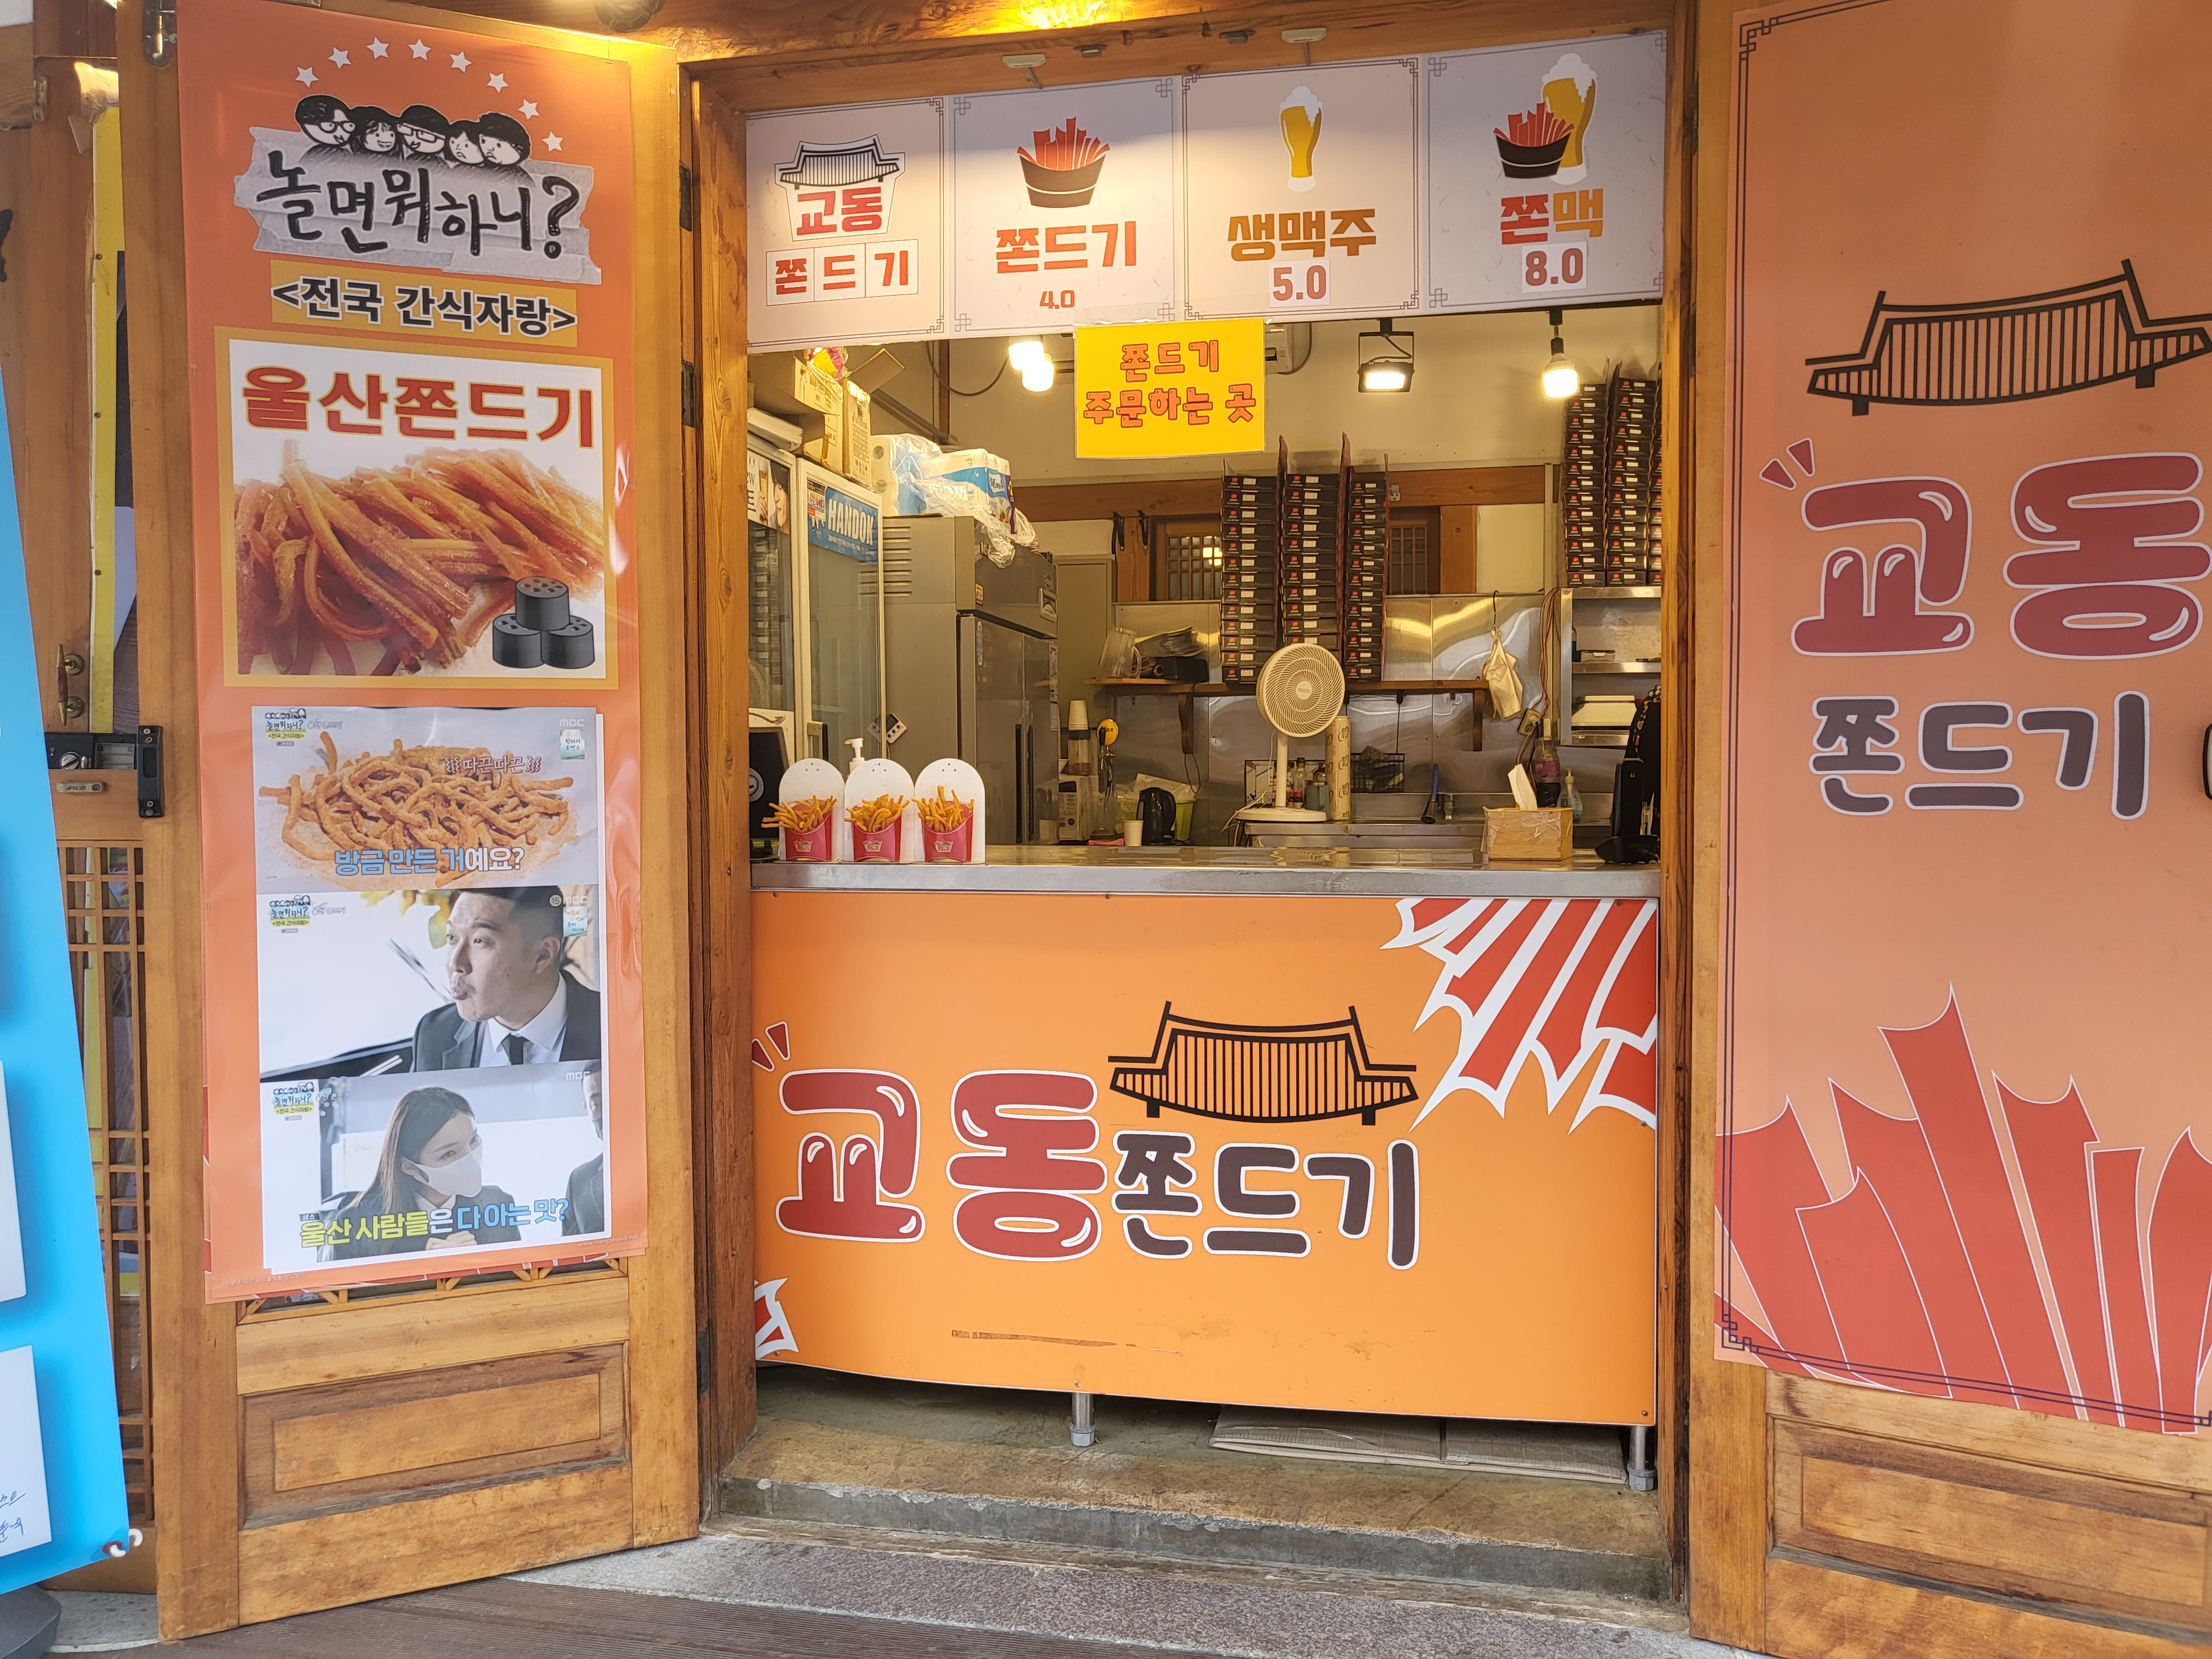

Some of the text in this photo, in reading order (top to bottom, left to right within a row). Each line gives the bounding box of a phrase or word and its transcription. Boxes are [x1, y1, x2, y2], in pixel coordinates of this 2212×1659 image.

[256, 150, 580, 259] 놀면뭐하니?
[797, 186, 882, 236] 교동
[1501, 188, 1604, 245] 쫀맥
[996, 221, 1136, 274] 쫀드기
[1228, 208, 1376, 262] 생맥주
[1272, 265, 1327, 301] 5.0
[1525, 248, 1584, 286] 8.0
[272, 275, 578, 337] <전국 간식자랑>
[1039, 290, 1075, 309] 4.0
[1120, 340, 1219, 382] 쫀드기
[242, 366, 594, 448] 울산쫀드기
[1083, 383, 1256, 428] 주문하는 곳
[828, 498, 874, 545] HANDOK
[1791, 452, 2212, 659] 교동
[463, 756, 525, 774] 따끈따끈
[1809, 691, 2150, 820] 쫀드기
[335, 847, 525, 876] 방금 만든 거예요?
[776, 1069, 1419, 1270] 교동 쫀드기
[300, 1218, 352, 1248] 울산
[355, 1208, 454, 1240] 사람들은
[457, 1205, 481, 1230] 다
[534, 1198, 570, 1224] 맛?
